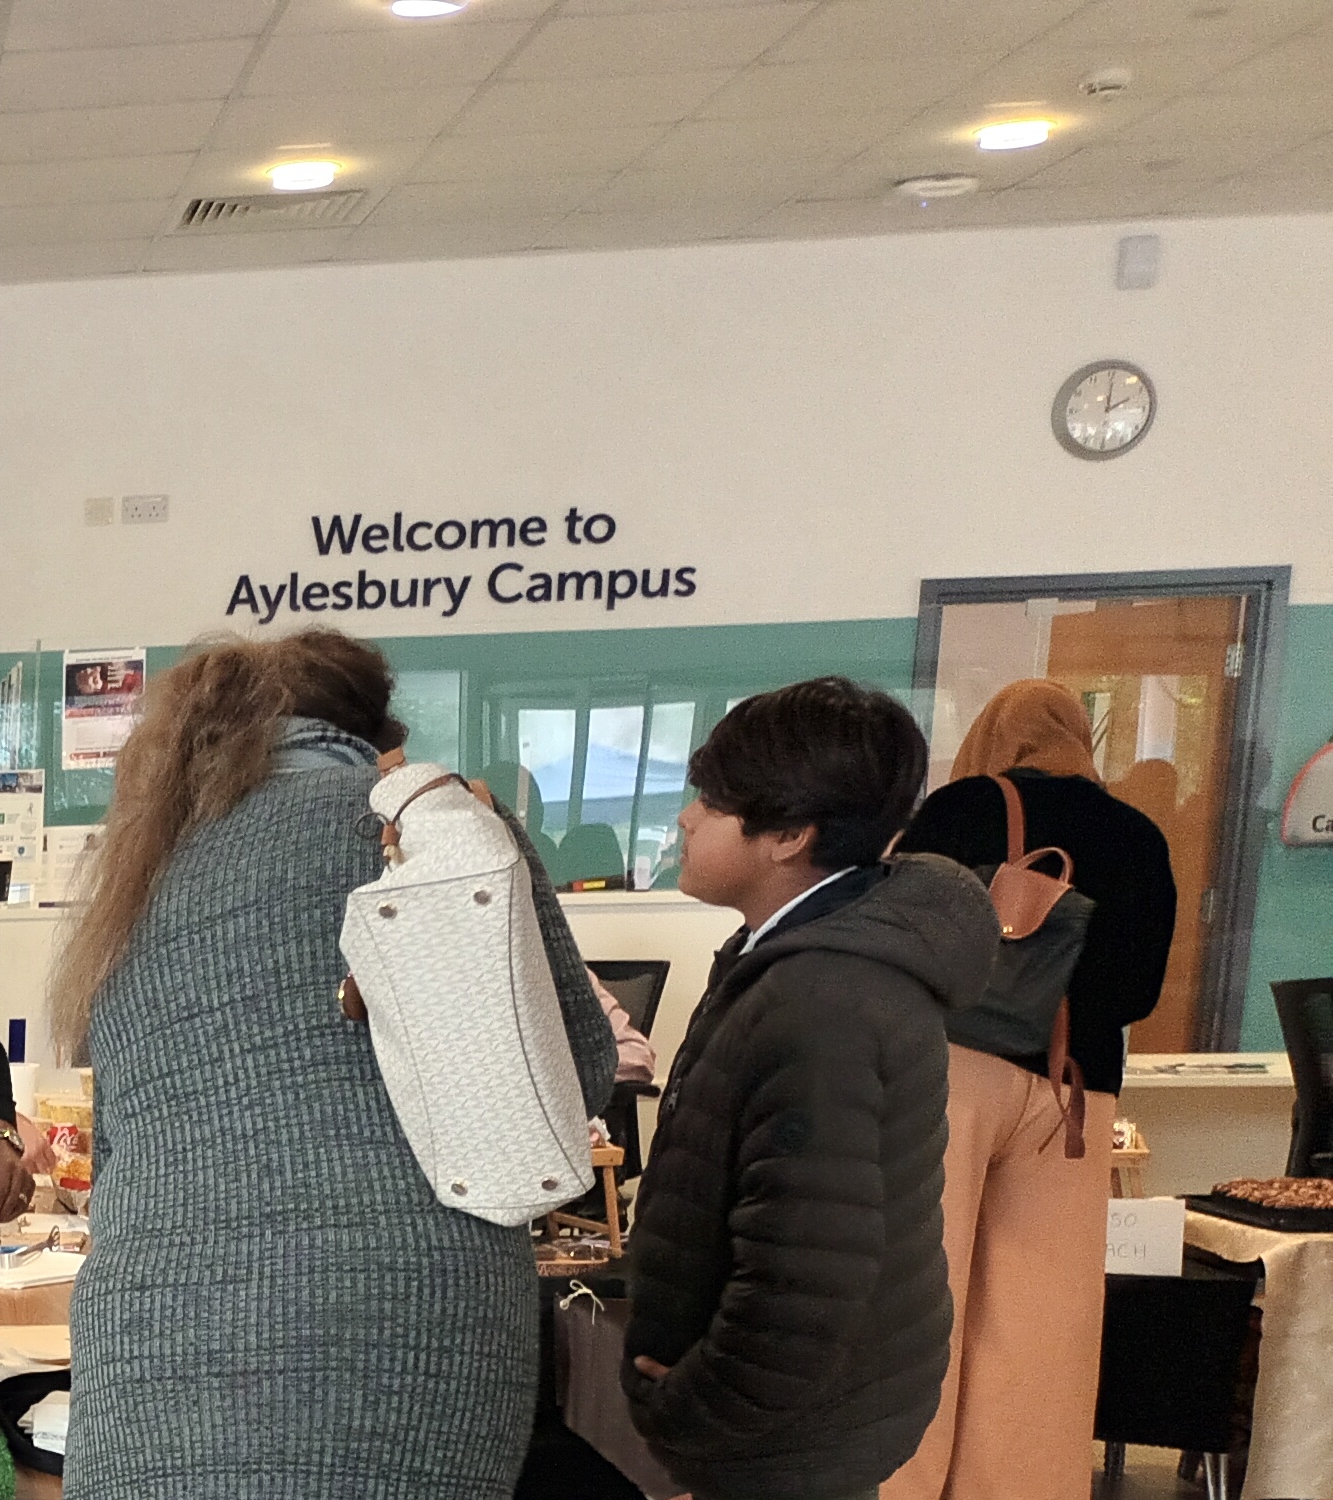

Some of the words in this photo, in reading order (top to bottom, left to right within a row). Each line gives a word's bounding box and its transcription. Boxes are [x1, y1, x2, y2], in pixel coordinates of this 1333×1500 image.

[310, 511, 548, 557] Welcome
[564, 506, 617, 545] to
[225, 569, 472, 625] Aylesbury
[486, 561, 697, 611] Campus
